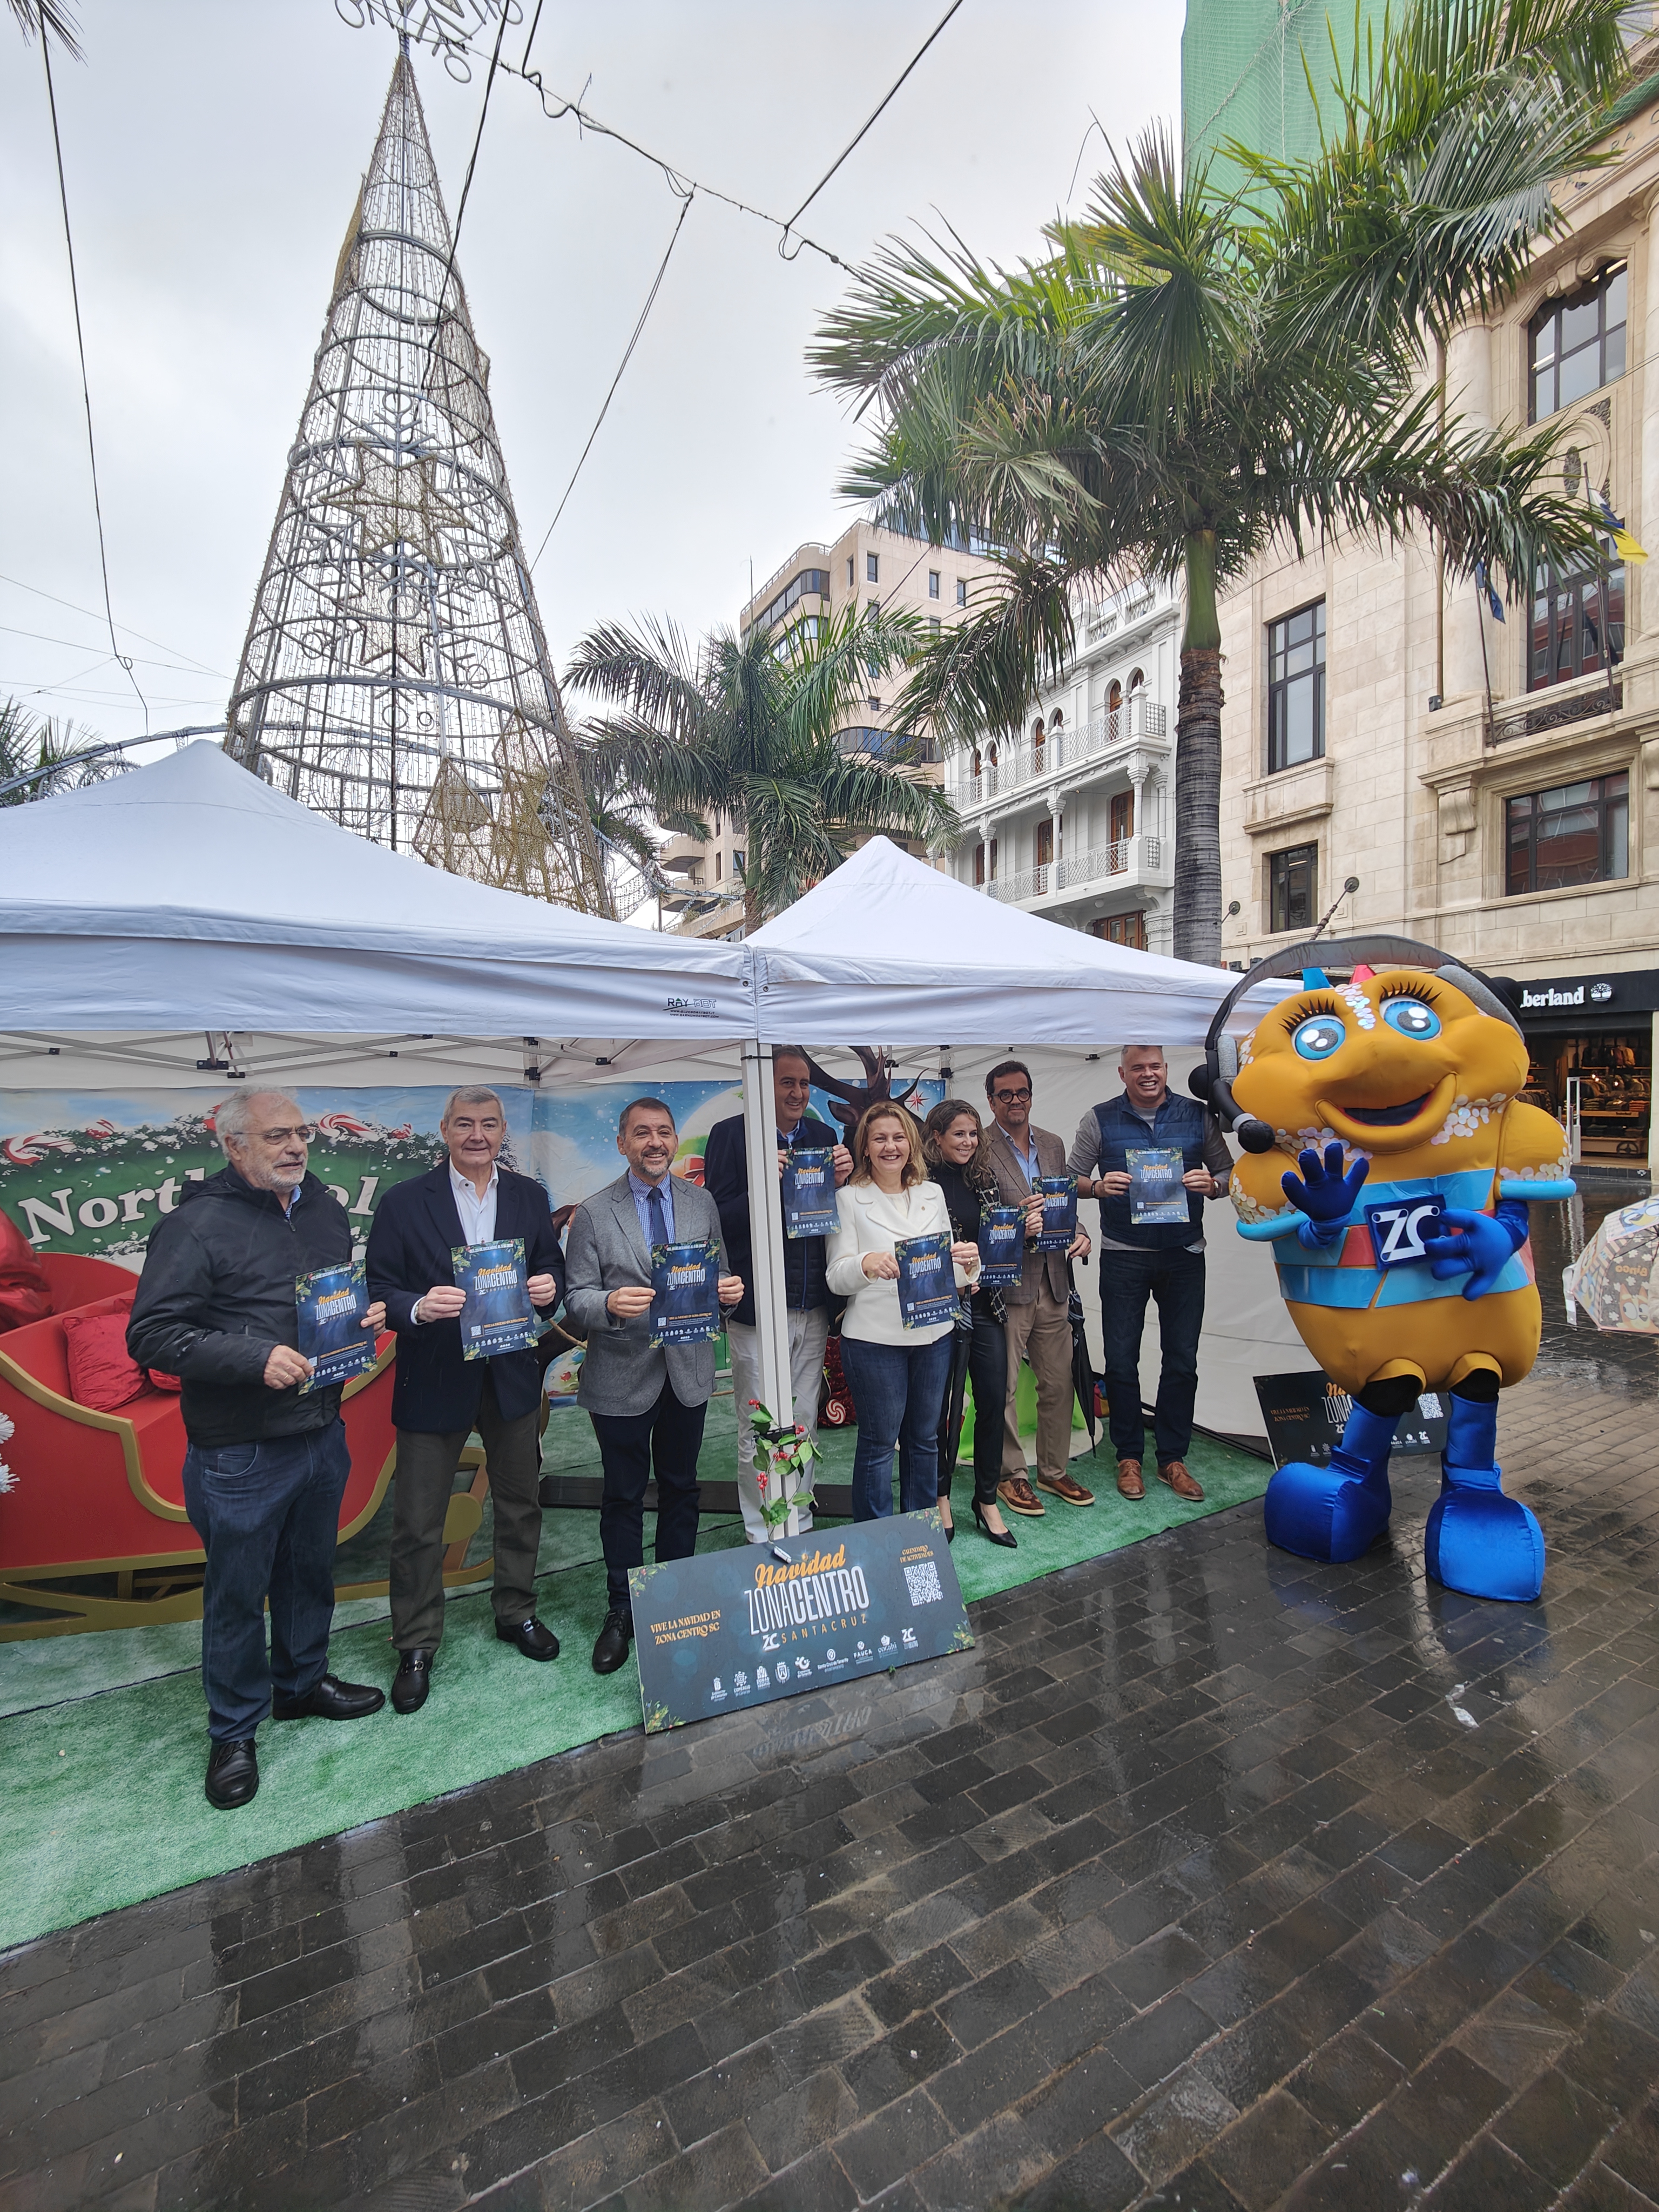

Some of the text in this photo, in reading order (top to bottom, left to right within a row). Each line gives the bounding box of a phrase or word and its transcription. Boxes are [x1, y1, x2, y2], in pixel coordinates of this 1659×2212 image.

[1520, 986, 1584, 1008] berland
[794, 1171, 824, 1185] ZONACENTRO
[798, 1166, 821, 1174] Navidad
[1140, 1169, 1172, 1179] ZONACENTRO
[18, 1168, 204, 1244] Nort
[989, 1229, 1016, 1240] ZONACENTRO
[908, 1257, 941, 1275] ZONACENTRO
[912, 1252, 936, 1264] Navidad
[478, 1263, 512, 1276] Navidad
[671, 1262, 701, 1273] Navidad
[474, 1270, 517, 1291] ZONACENTRO
[667, 1269, 705, 1286] ZONACENTRO
[318, 1287, 349, 1305] Navidad
[314, 1294, 356, 1320] ZONACENTRO
[901, 1545, 929, 1556] CALENDARIO
[755, 1543, 846, 1588] Navidad
[744, 1566, 869, 1636] ZONACENTRO
[650, 1609, 721, 1634] VIVE LA NAVIDAD EN
[655, 1631, 677, 1645] ZONA
[677, 1624, 709, 1640] CENTRO
